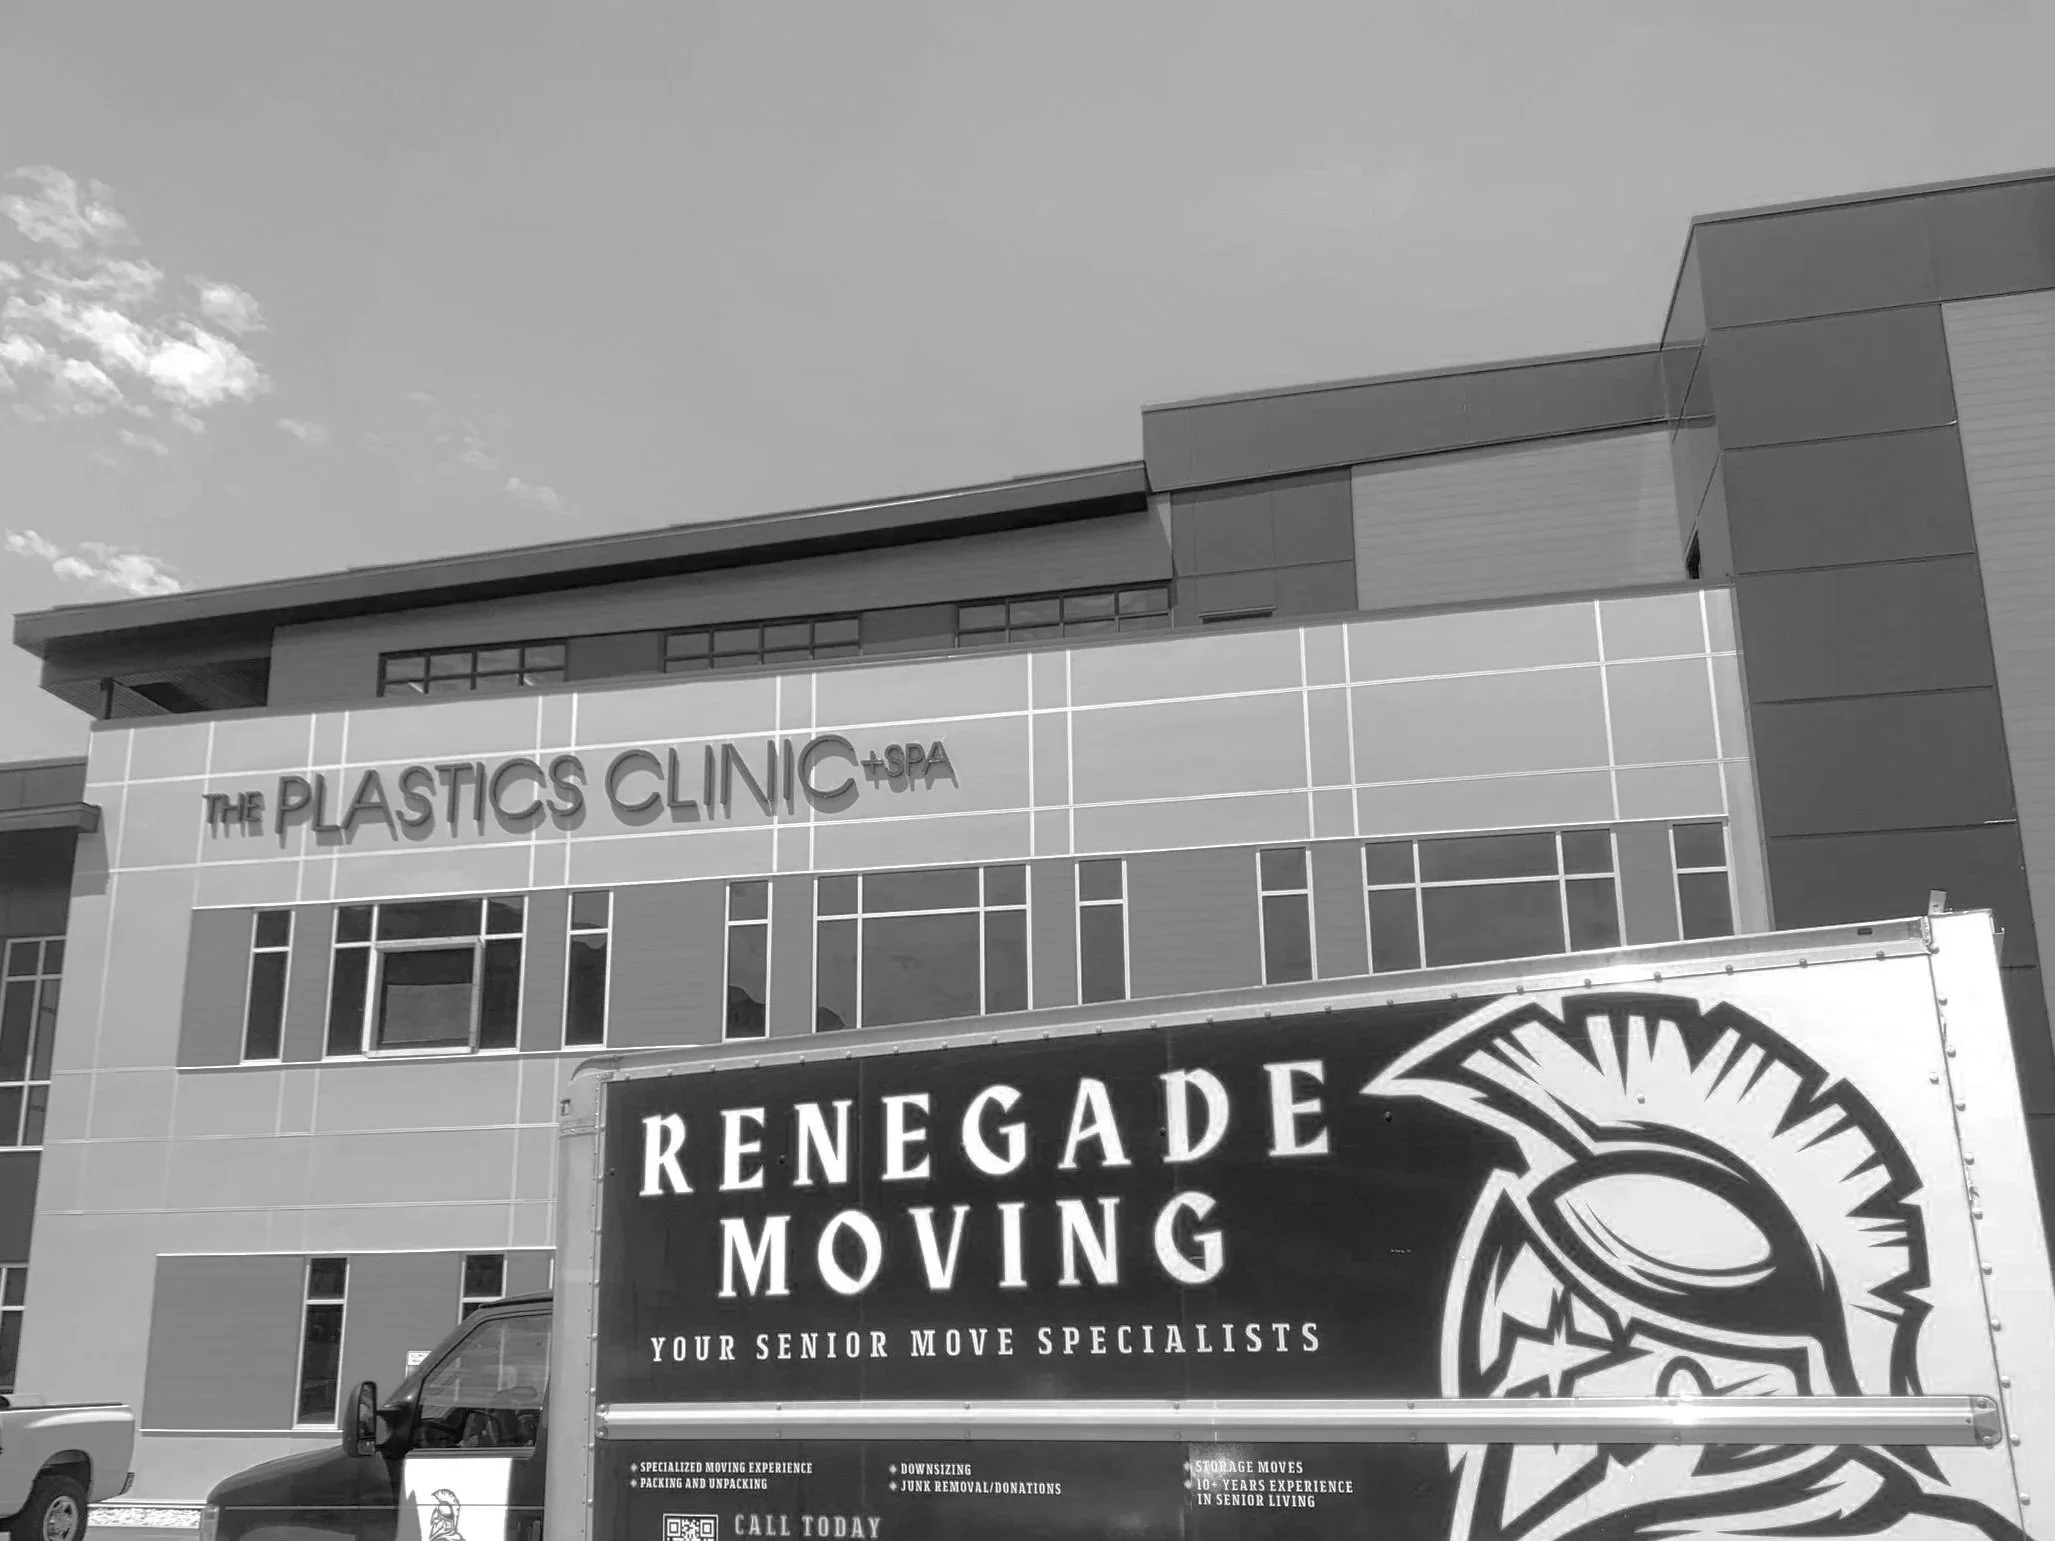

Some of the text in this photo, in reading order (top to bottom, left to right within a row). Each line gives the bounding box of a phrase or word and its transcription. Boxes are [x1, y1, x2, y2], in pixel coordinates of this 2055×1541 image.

[203, 790, 264, 830] THE
[275, 754, 587, 843] PLASTICS
[605, 733, 858, 818] CLINIC
[639, 1059, 1330, 1196] RENEGADE
[718, 1191, 1225, 1298] MOVING
[650, 1322, 1320, 1362] YOUR SENIOR MOVE SPECIALISTS
[640, 1461, 813, 1474] SPECIALIZED MOVING EXPERIENCE
[900, 1462, 972, 1476] DOWNSIZING
[1195, 1460, 1304, 1474] STORAGE MOVES
[640, 1477, 768, 1490] PACKING AND UNPACKING
[900, 1479, 1062, 1495] JUNK REMOVAL/DONATIONS
[1197, 1479, 1354, 1493] 10+ YEARS EXPERIENCE
[1197, 1493, 1315, 1508] IN SENIOR LIVING
[734, 1513, 882, 1539] CALL TODAY
